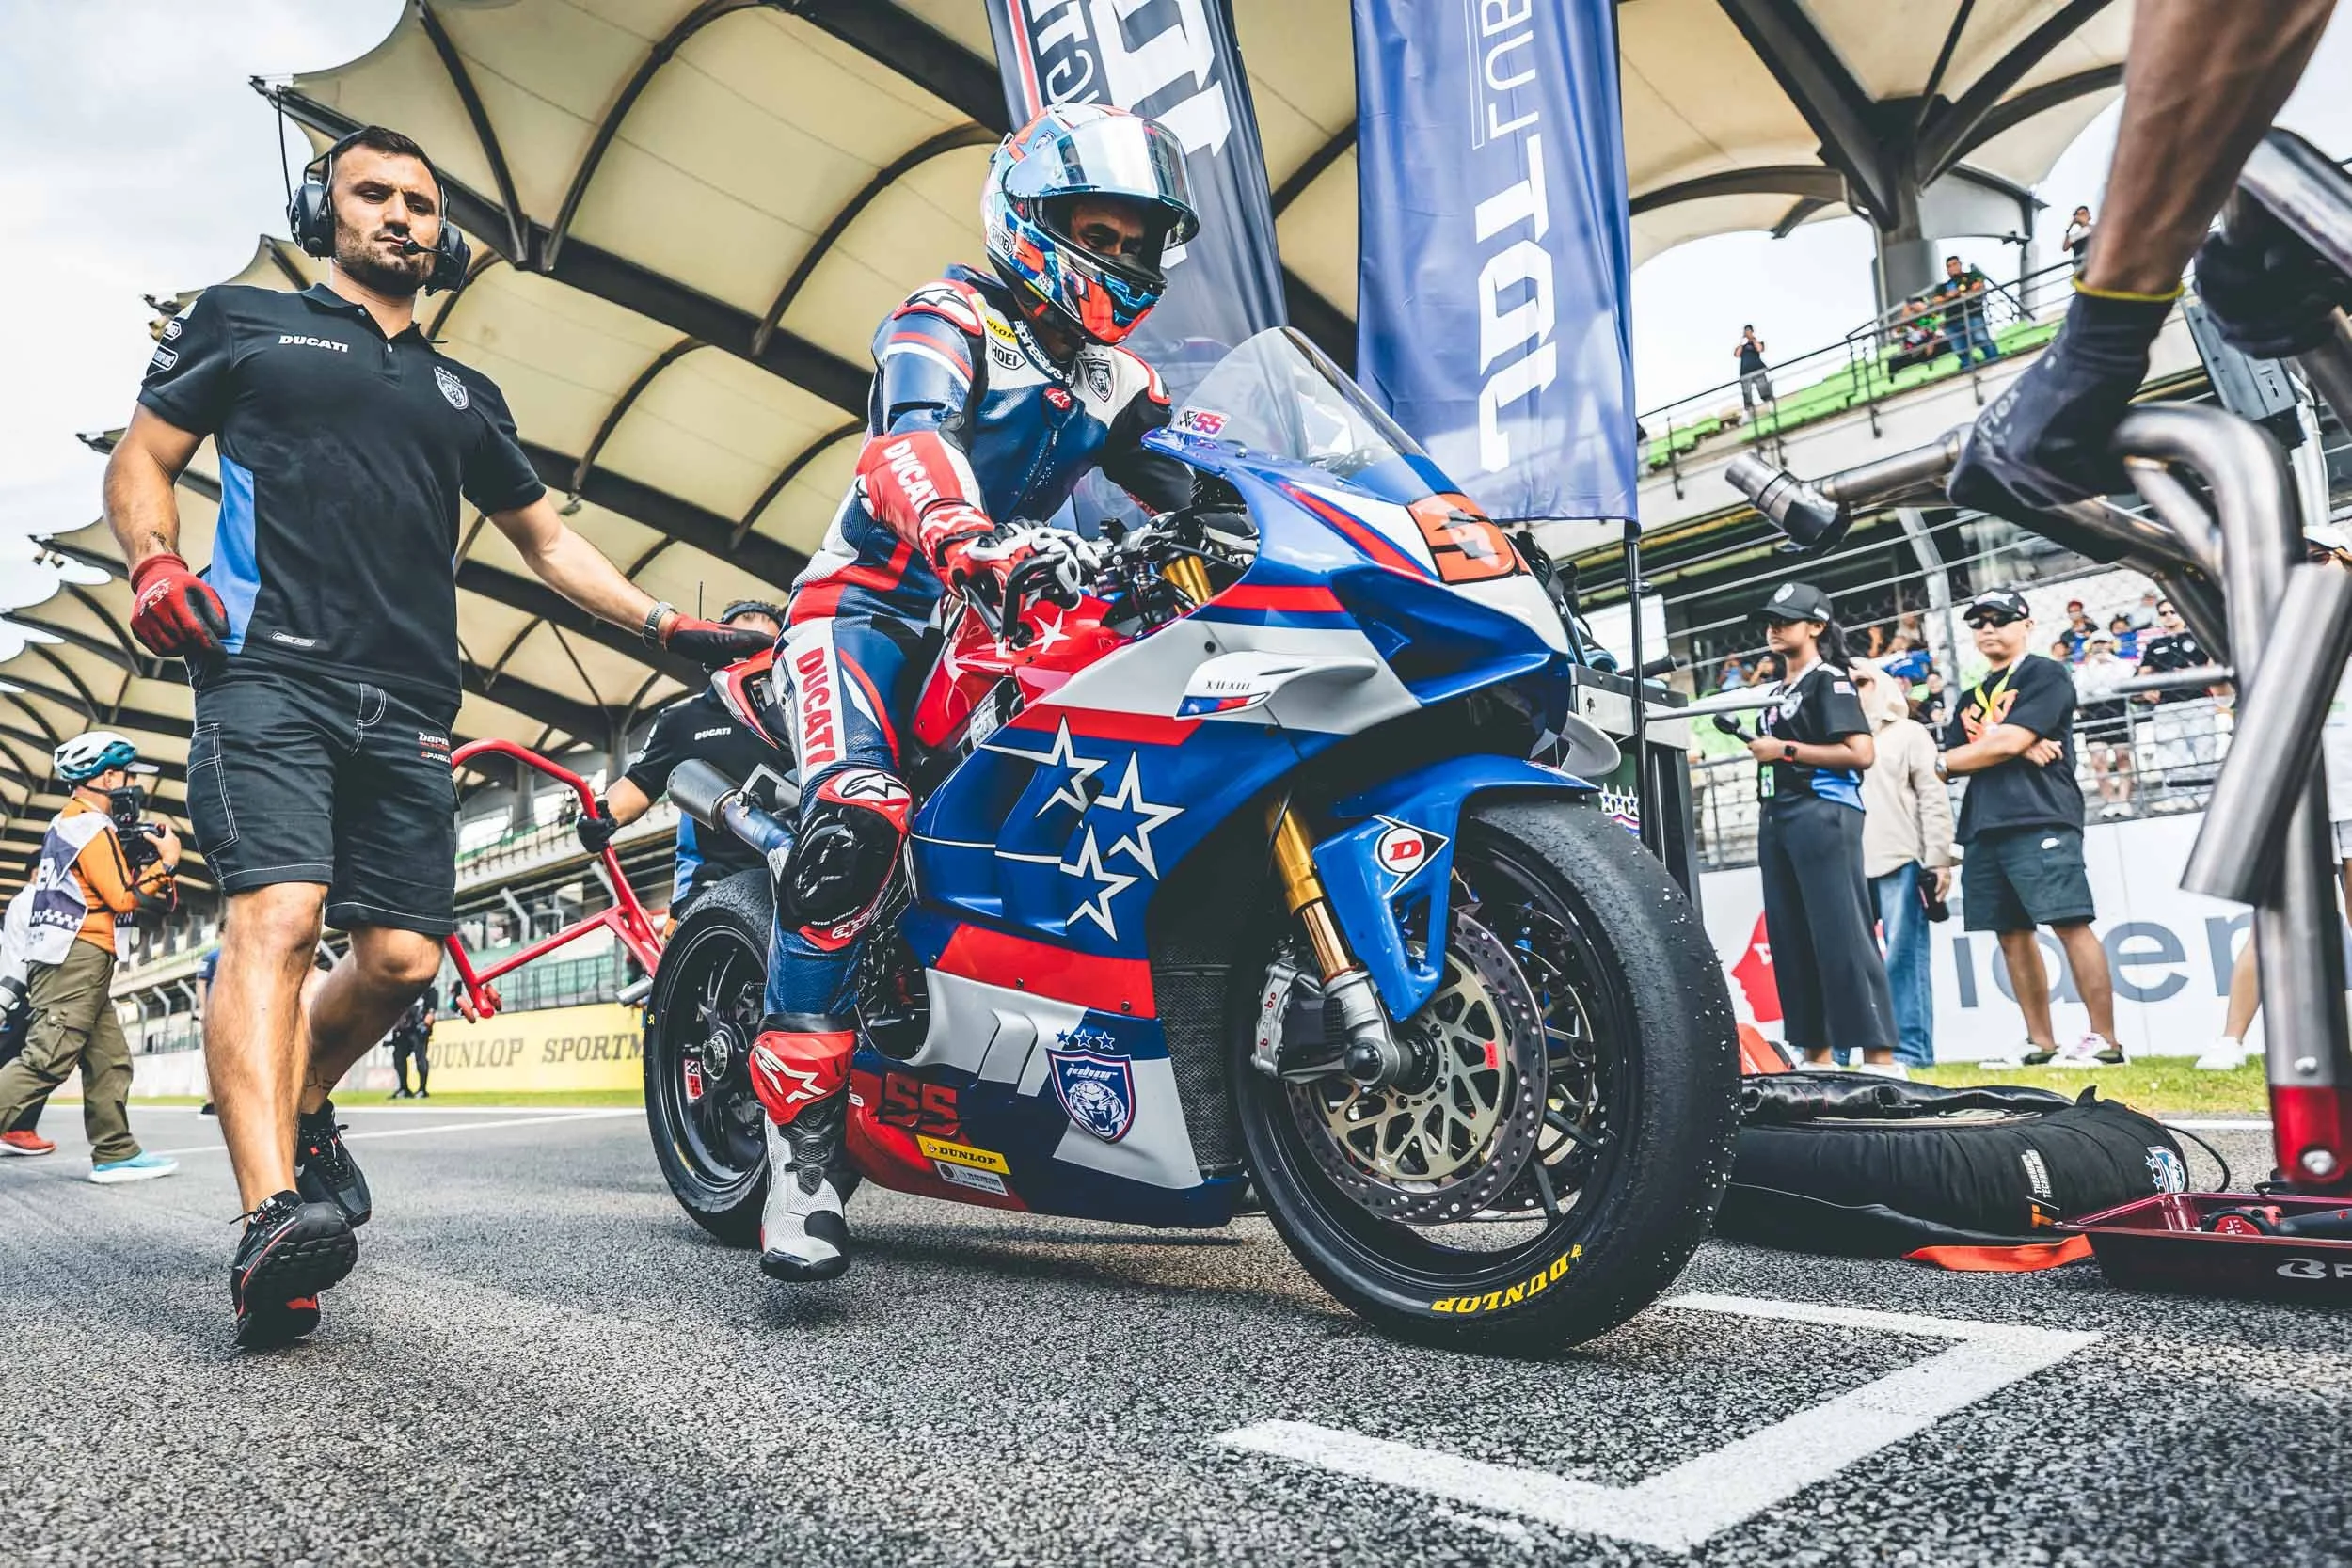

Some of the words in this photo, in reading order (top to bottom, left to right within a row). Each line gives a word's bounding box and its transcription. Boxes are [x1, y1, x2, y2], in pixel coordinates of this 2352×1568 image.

[991, 229, 1011, 252] SHOEI
[986, 317, 1015, 340] NLOP
[278, 335, 349, 353] DUCATI
[990, 339, 1018, 367] HOEI
[882, 438, 941, 517] DUCAT
[796, 646, 836, 768] DUCATI
[694, 727, 732, 741] DUCATI
[428, 1037, 524, 1070] DUNLOP
[939, 1146, 997, 1165] DUNLOP
[1431, 1251, 1570, 1313] DUNLOP
